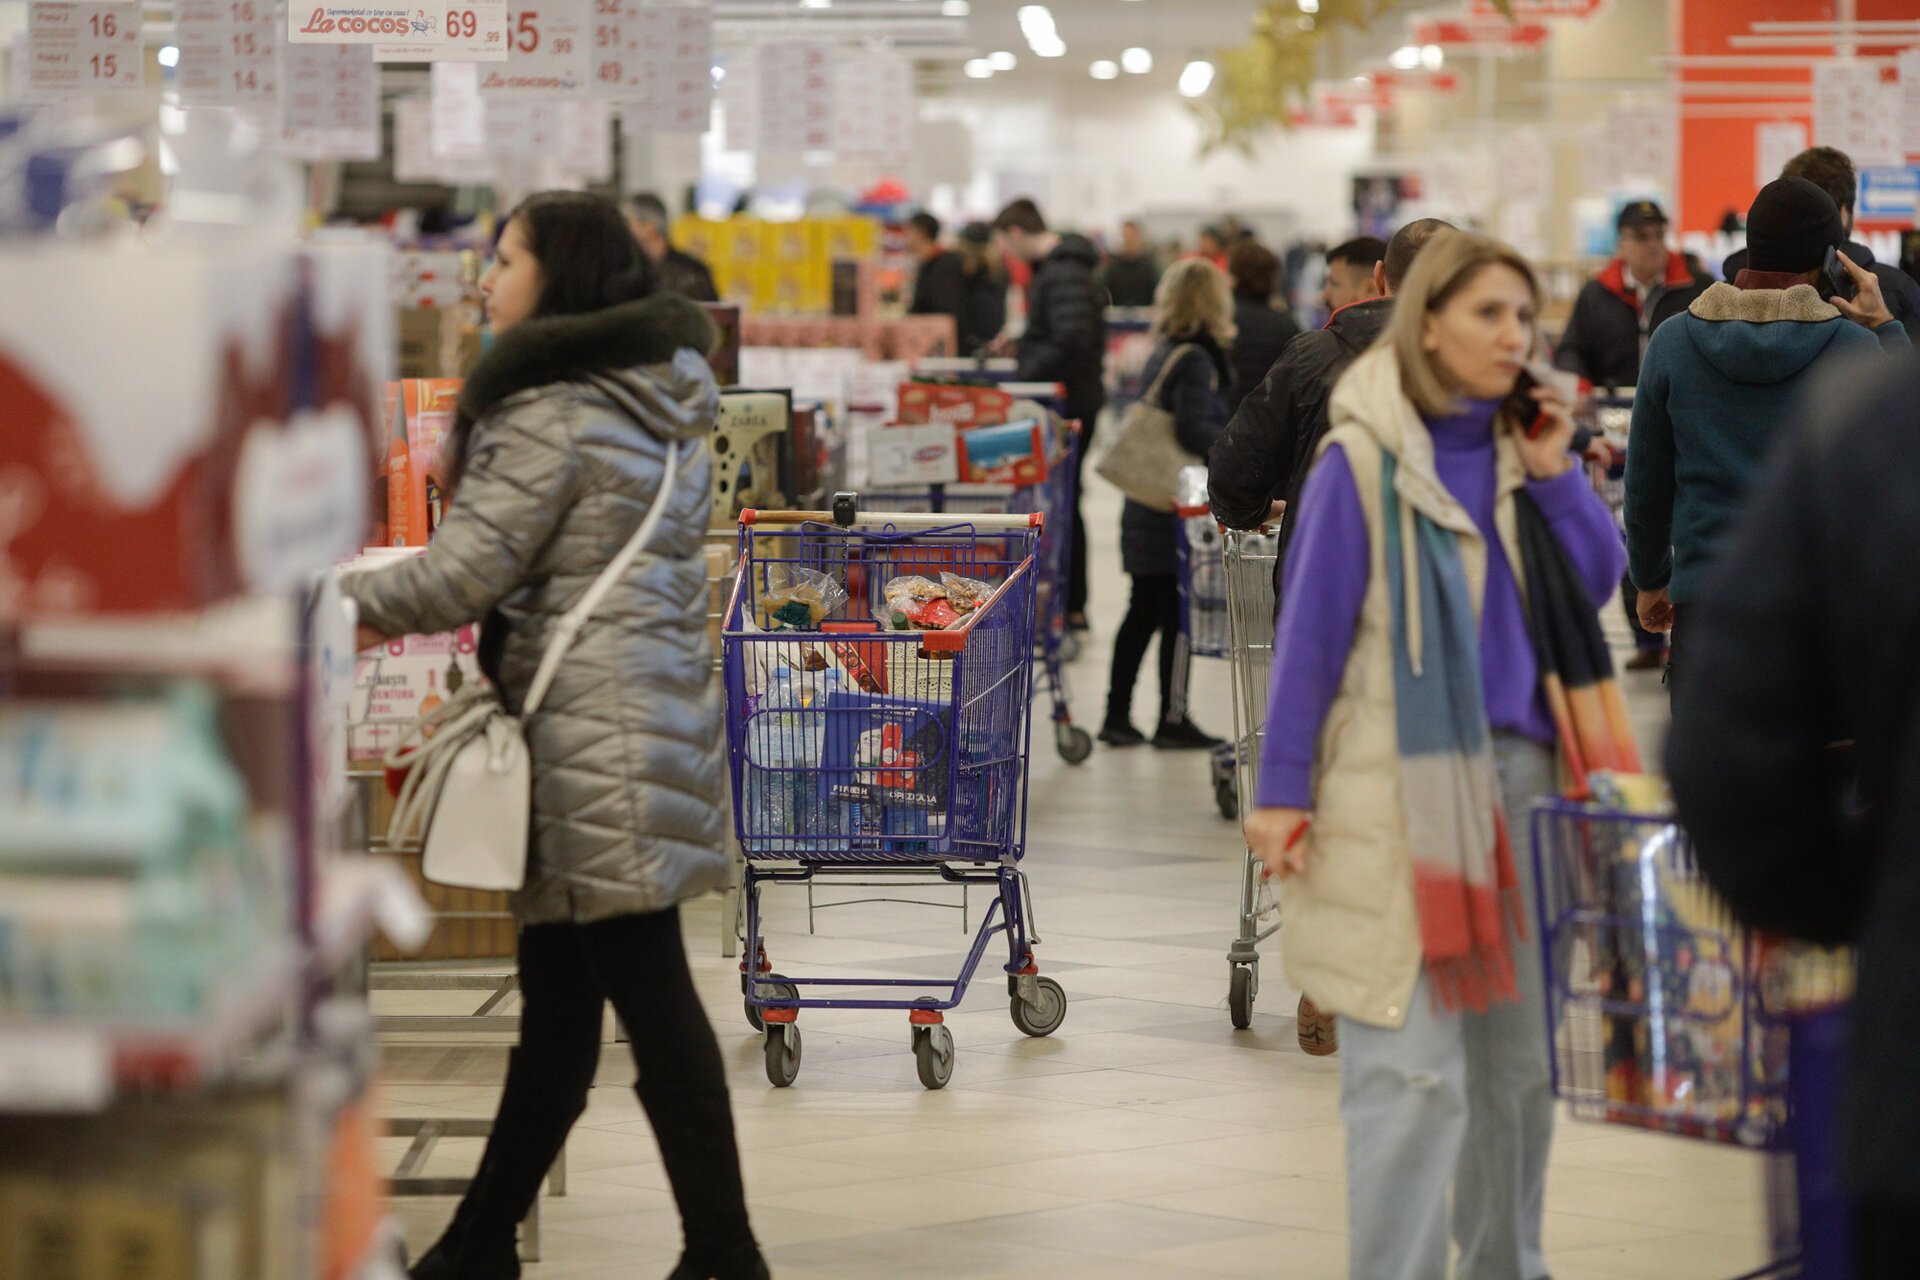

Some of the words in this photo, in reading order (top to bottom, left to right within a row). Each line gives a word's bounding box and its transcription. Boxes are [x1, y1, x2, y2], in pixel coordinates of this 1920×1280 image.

[88, 12, 117, 39] 16
[299, 7, 336, 34] La
[446, 10, 477, 38] 69
[89, 53, 118, 79] 15
